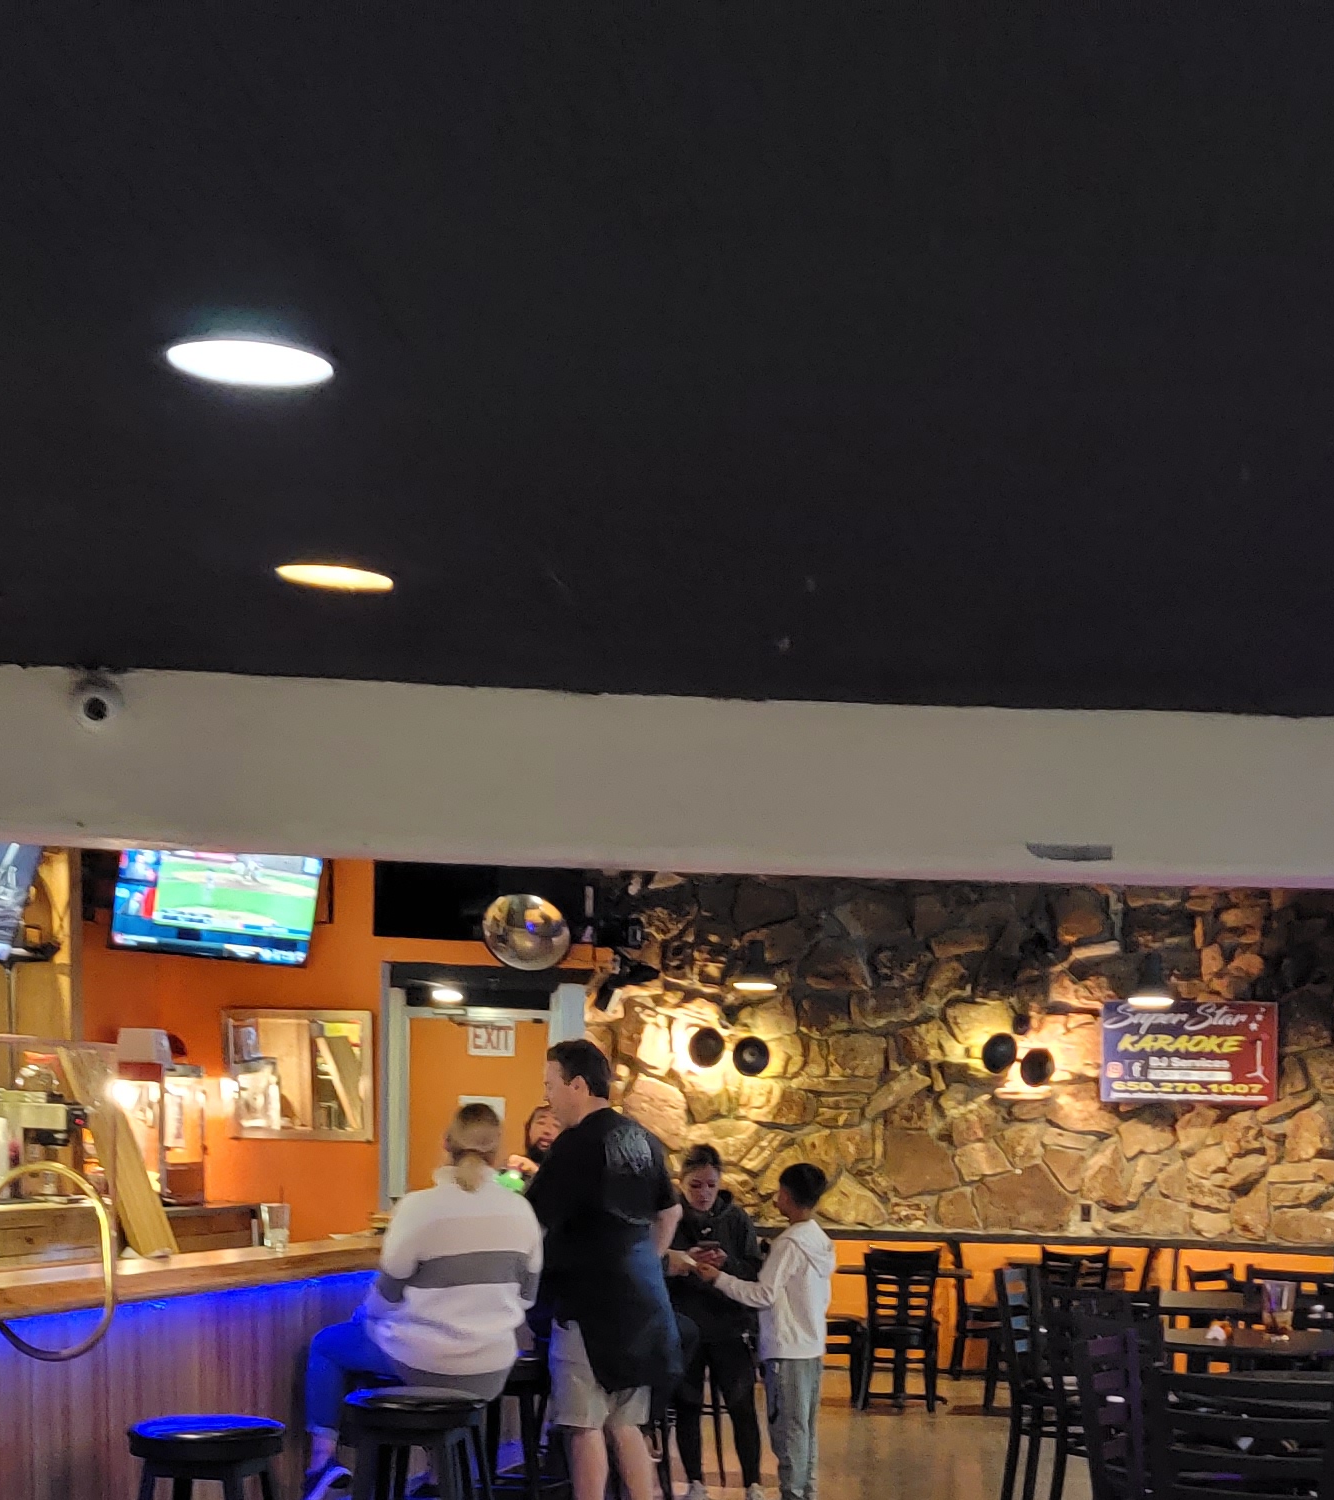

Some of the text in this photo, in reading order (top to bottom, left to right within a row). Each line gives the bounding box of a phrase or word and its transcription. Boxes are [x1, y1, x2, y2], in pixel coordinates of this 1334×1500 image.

[1104, 1002, 1249, 1034] Super Star
[473, 1024, 514, 1050] EXIT
[1118, 1033, 1248, 1054] KARAOKE
[1111, 1080, 1264, 1093] 650.270.1007
